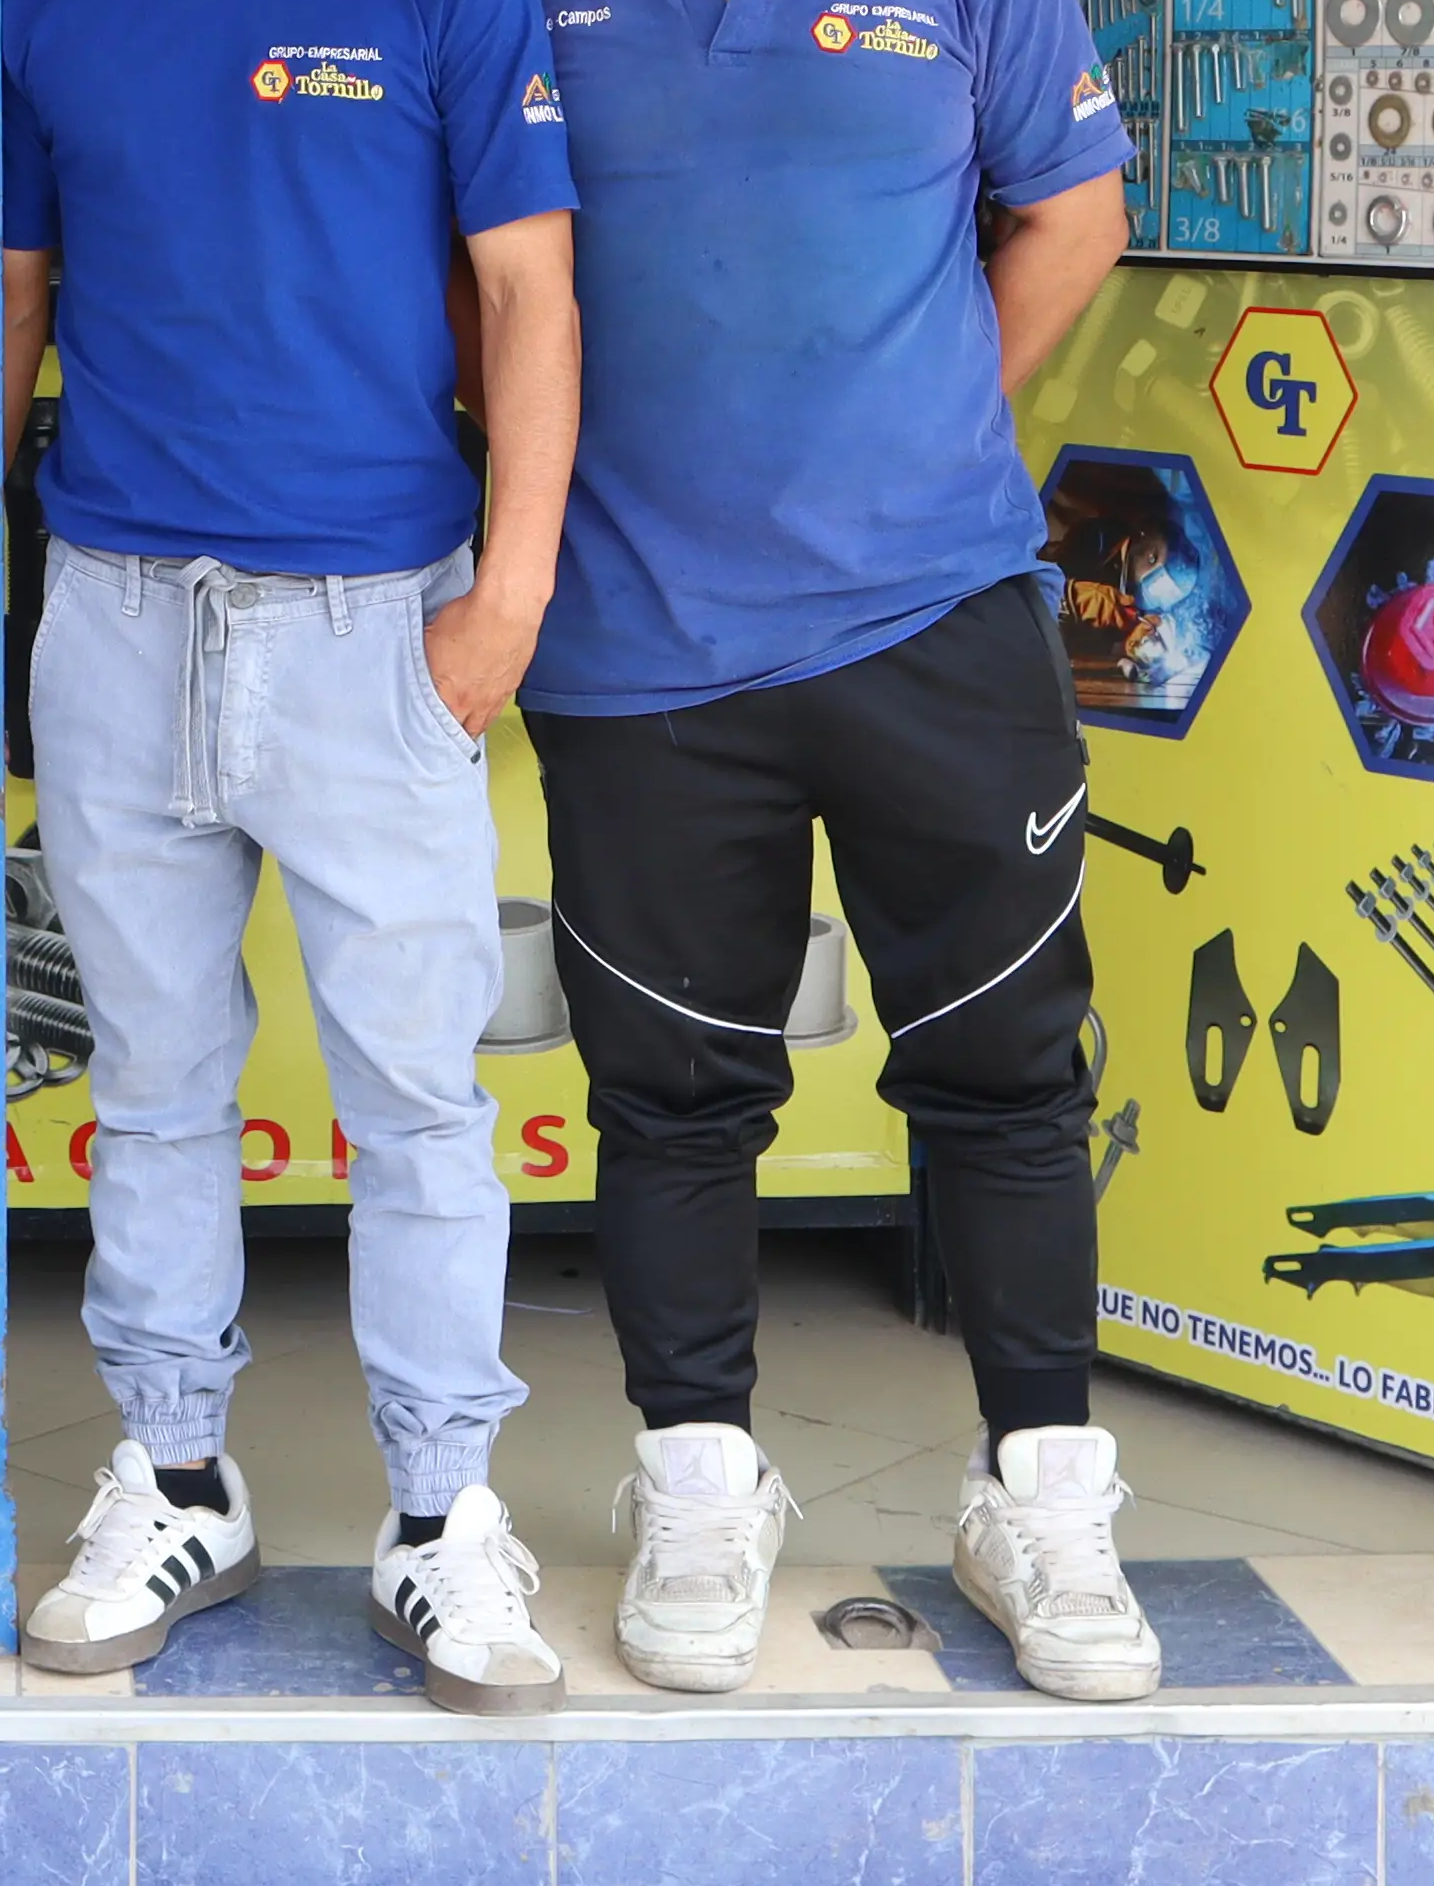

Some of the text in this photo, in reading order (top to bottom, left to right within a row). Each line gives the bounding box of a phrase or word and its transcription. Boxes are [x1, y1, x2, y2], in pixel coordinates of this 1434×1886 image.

[558, 6, 612, 26] Campos
[830, 3, 939, 27] GRUPO EMPRESARIAL
[269, 46, 383, 61] GRUPO EMPRESARIAL
[859, 31, 938, 60] Tornillo
[322, 61, 338, 73] La
[296, 75, 383, 100] Tornillo
[1175, 217, 1221, 243] 3/8
[1246, 351, 1317, 436] GT
[1096, 1289, 1134, 1321] UE
[1142, 1301, 1180, 1333] NO
[1188, 1315, 1331, 1382] TENEMOS...
[1339, 1360, 1372, 1393] LO
